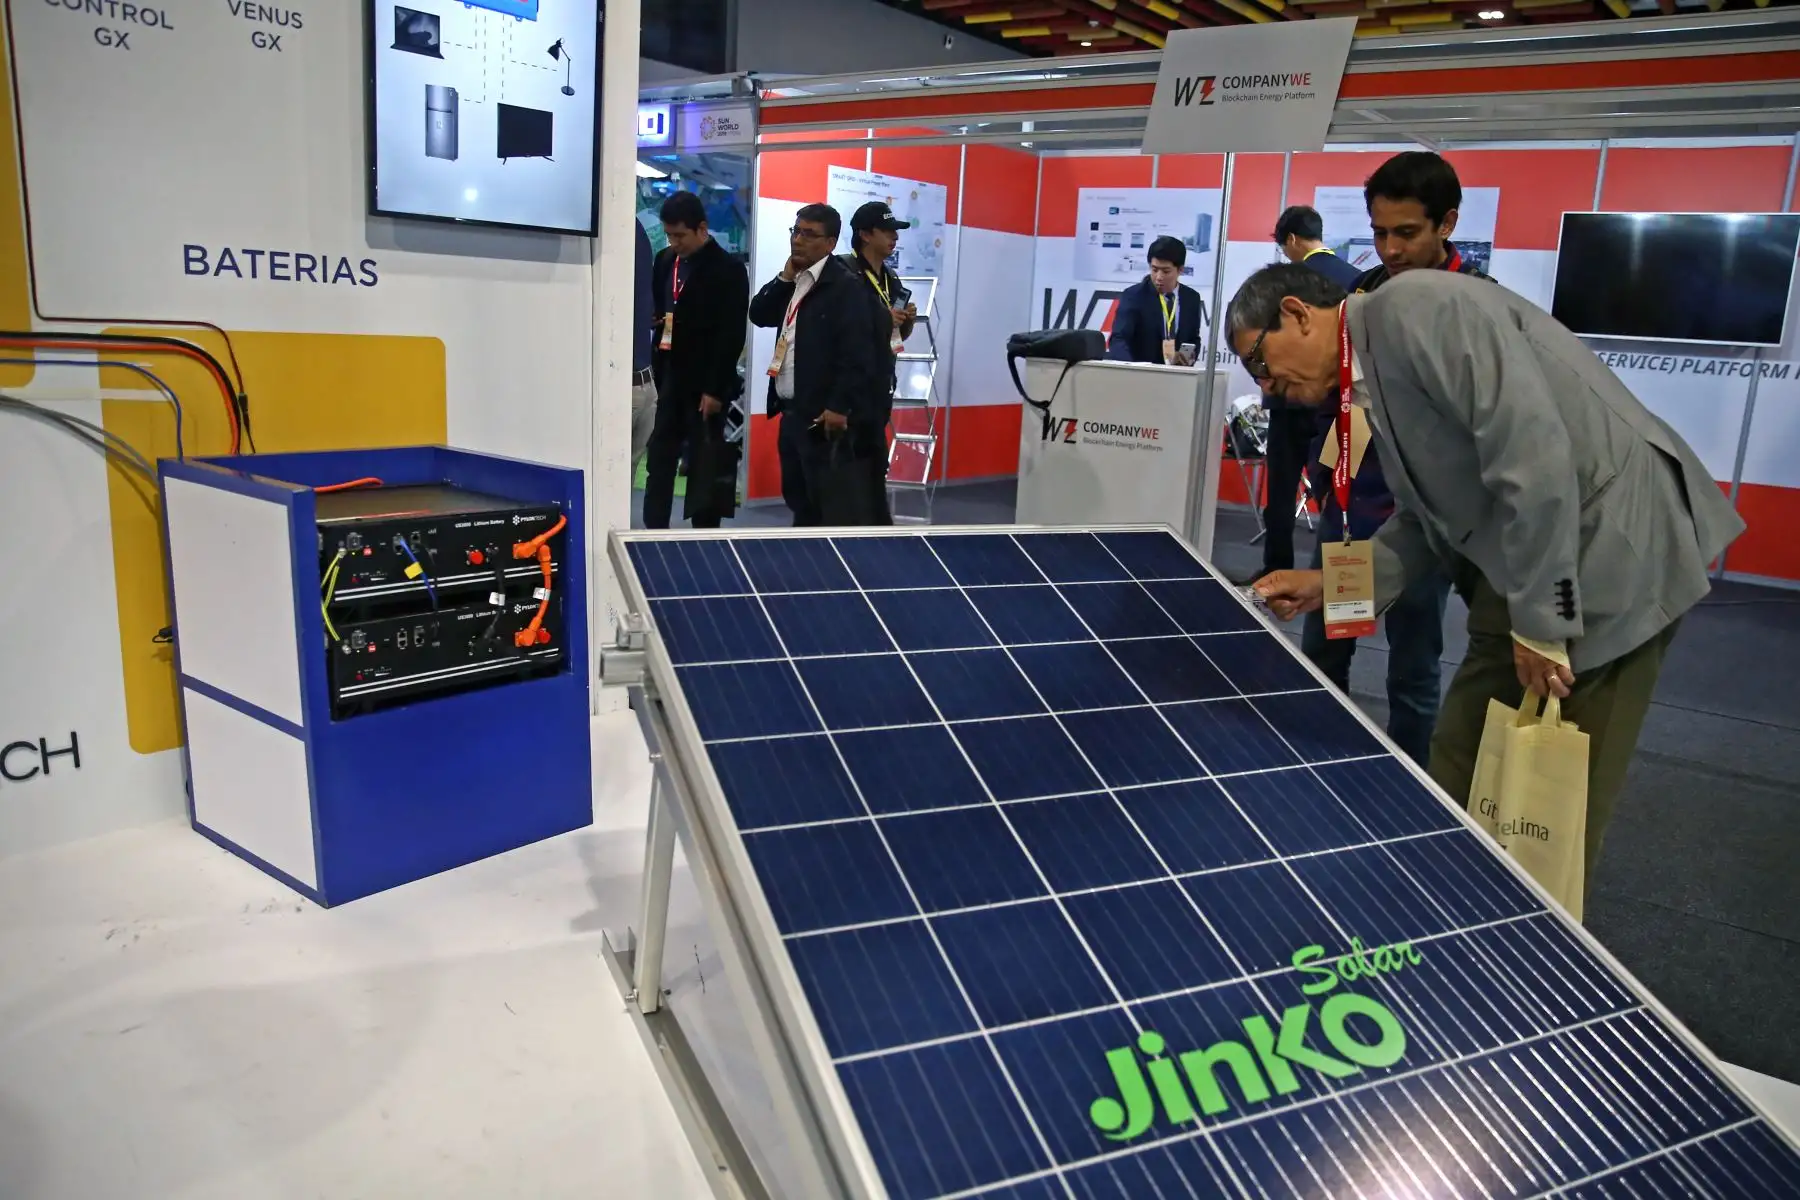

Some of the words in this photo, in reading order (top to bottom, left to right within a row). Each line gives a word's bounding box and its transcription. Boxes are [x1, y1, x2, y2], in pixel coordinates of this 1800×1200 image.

[228, 0, 303, 29] VENUS
[94, 27, 130, 50] GX
[251, 31, 282, 52] GX
[1222, 93, 1258, 102] Blockchain
[1260, 93, 1283, 102] Energy
[1284, 92, 1315, 100] Platform
[183, 244, 378, 287] BATERIAS
[1680, 358, 1790, 379] PLATFORM
[1083, 437, 1115, 447] Blockchain
[1115, 440, 1135, 450] Energy
[1136, 442, 1163, 452] Platform
[1292, 937, 1421, 994] Solar
